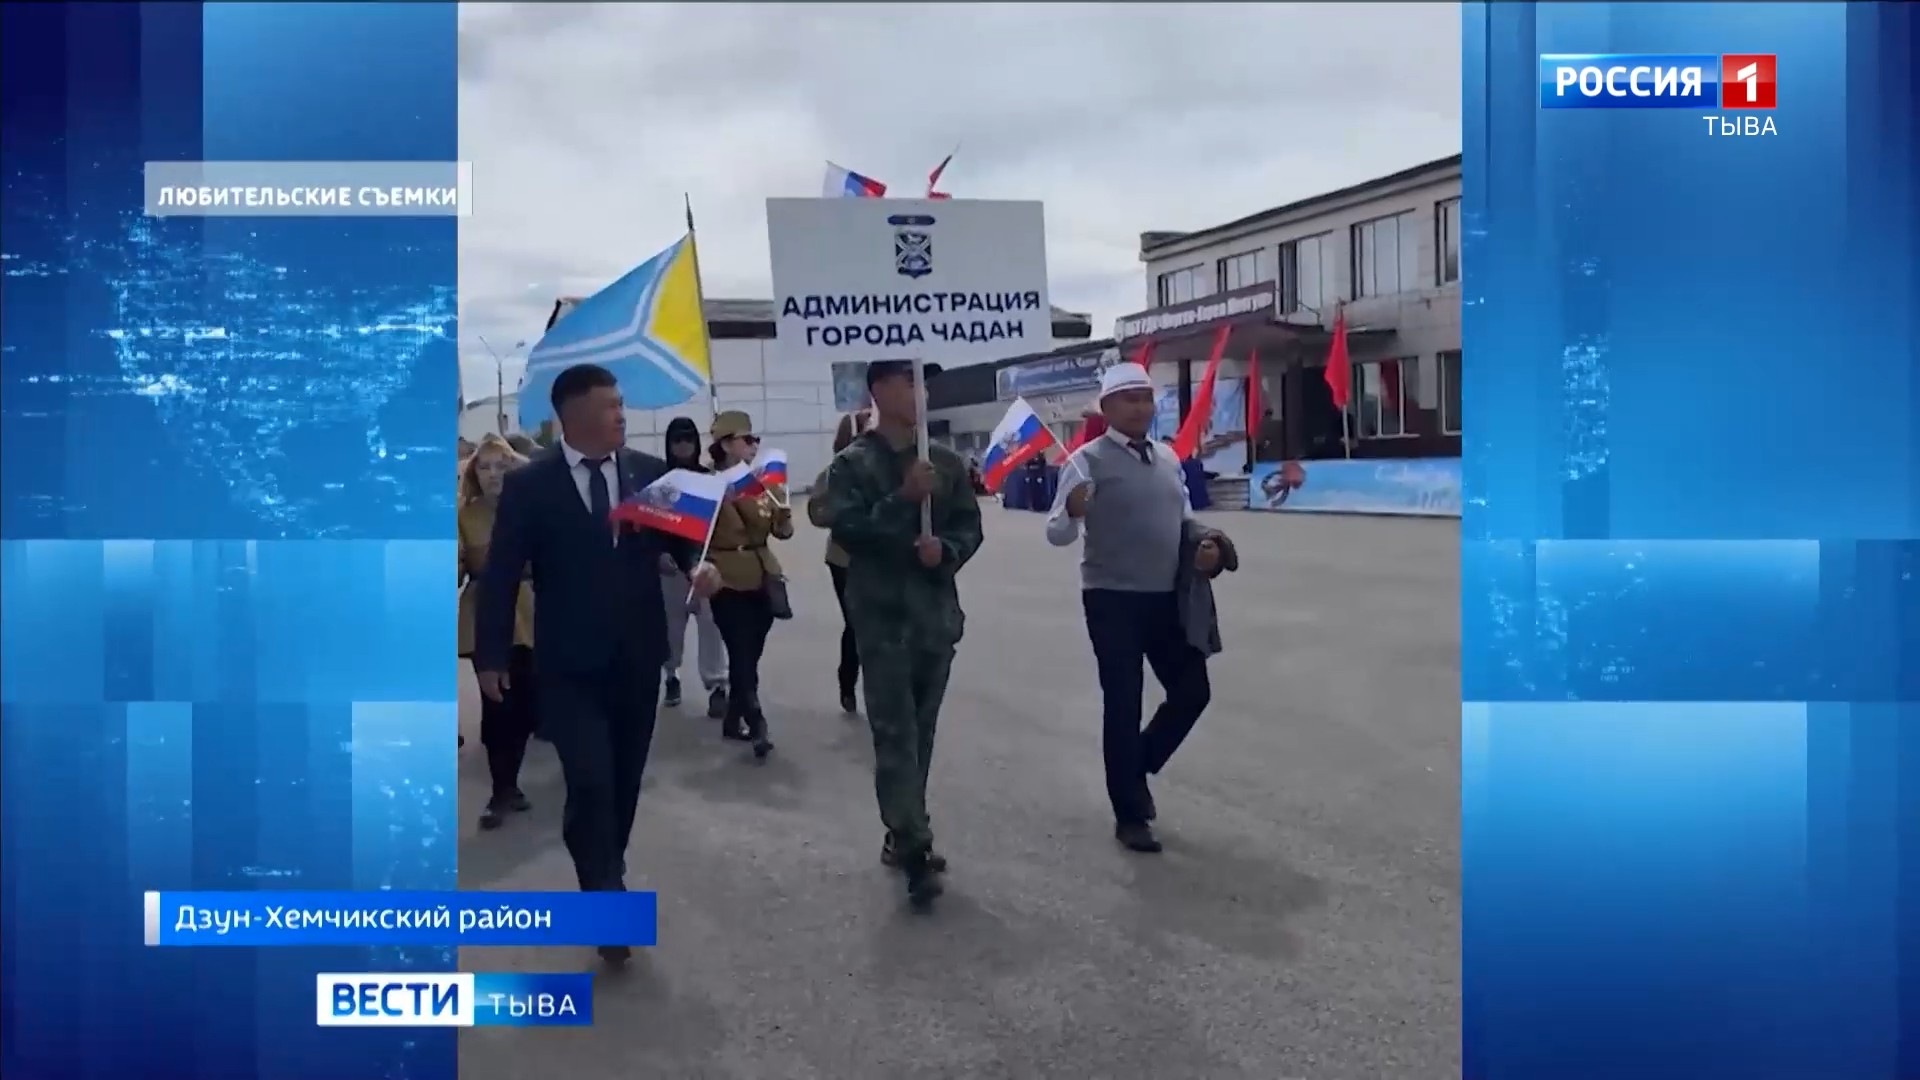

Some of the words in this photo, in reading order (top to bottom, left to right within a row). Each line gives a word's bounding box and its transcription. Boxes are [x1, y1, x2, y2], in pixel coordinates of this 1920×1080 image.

[782, 291, 1041, 320] АДМИНИСТРАЦИЯ
[806, 323, 925, 347] ГОРОДА
[931, 320, 1024, 342] ЧАДАН
